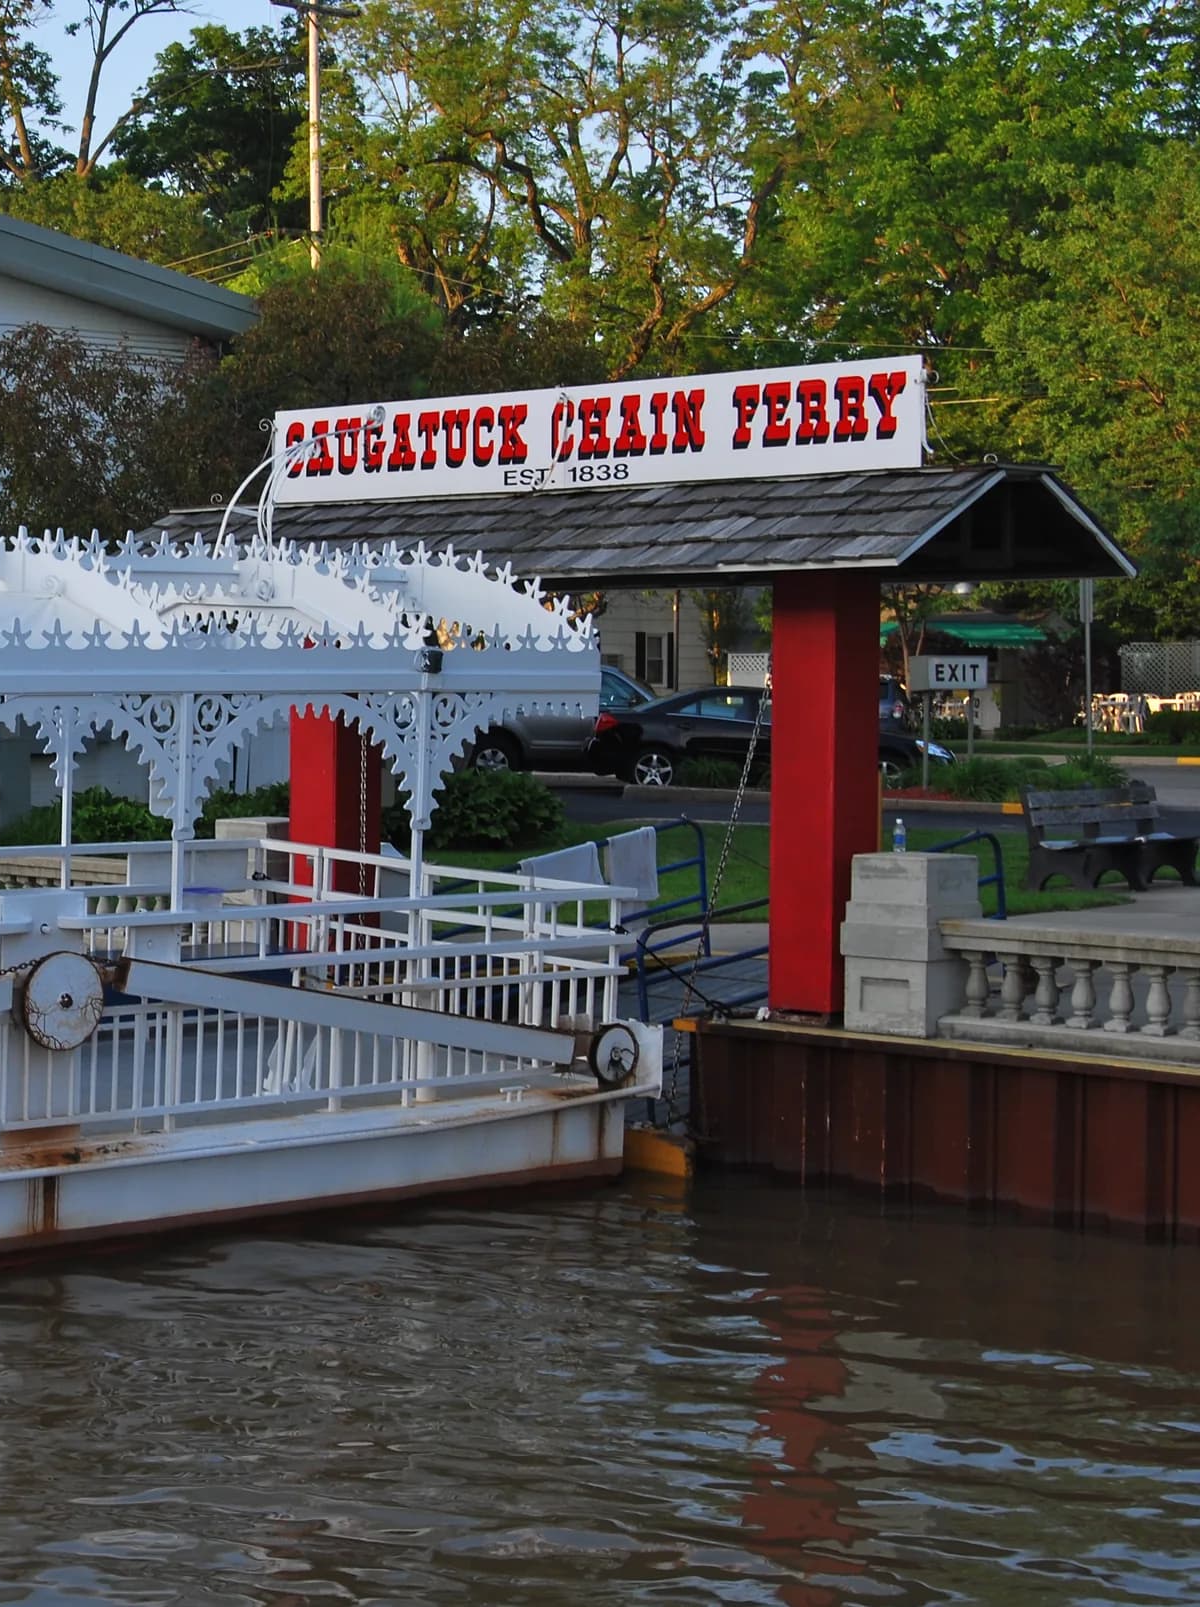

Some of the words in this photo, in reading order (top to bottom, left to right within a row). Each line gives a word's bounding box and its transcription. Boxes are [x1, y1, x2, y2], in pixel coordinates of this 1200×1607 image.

[286, 403, 528, 479] SAUGATUCK
[551, 388, 706, 463] CHAIN
[732, 371, 907, 450] FERRY
[503, 468, 555, 486] EST.
[567, 463, 629, 482] 1838
[935, 664, 979, 682] EXIT
